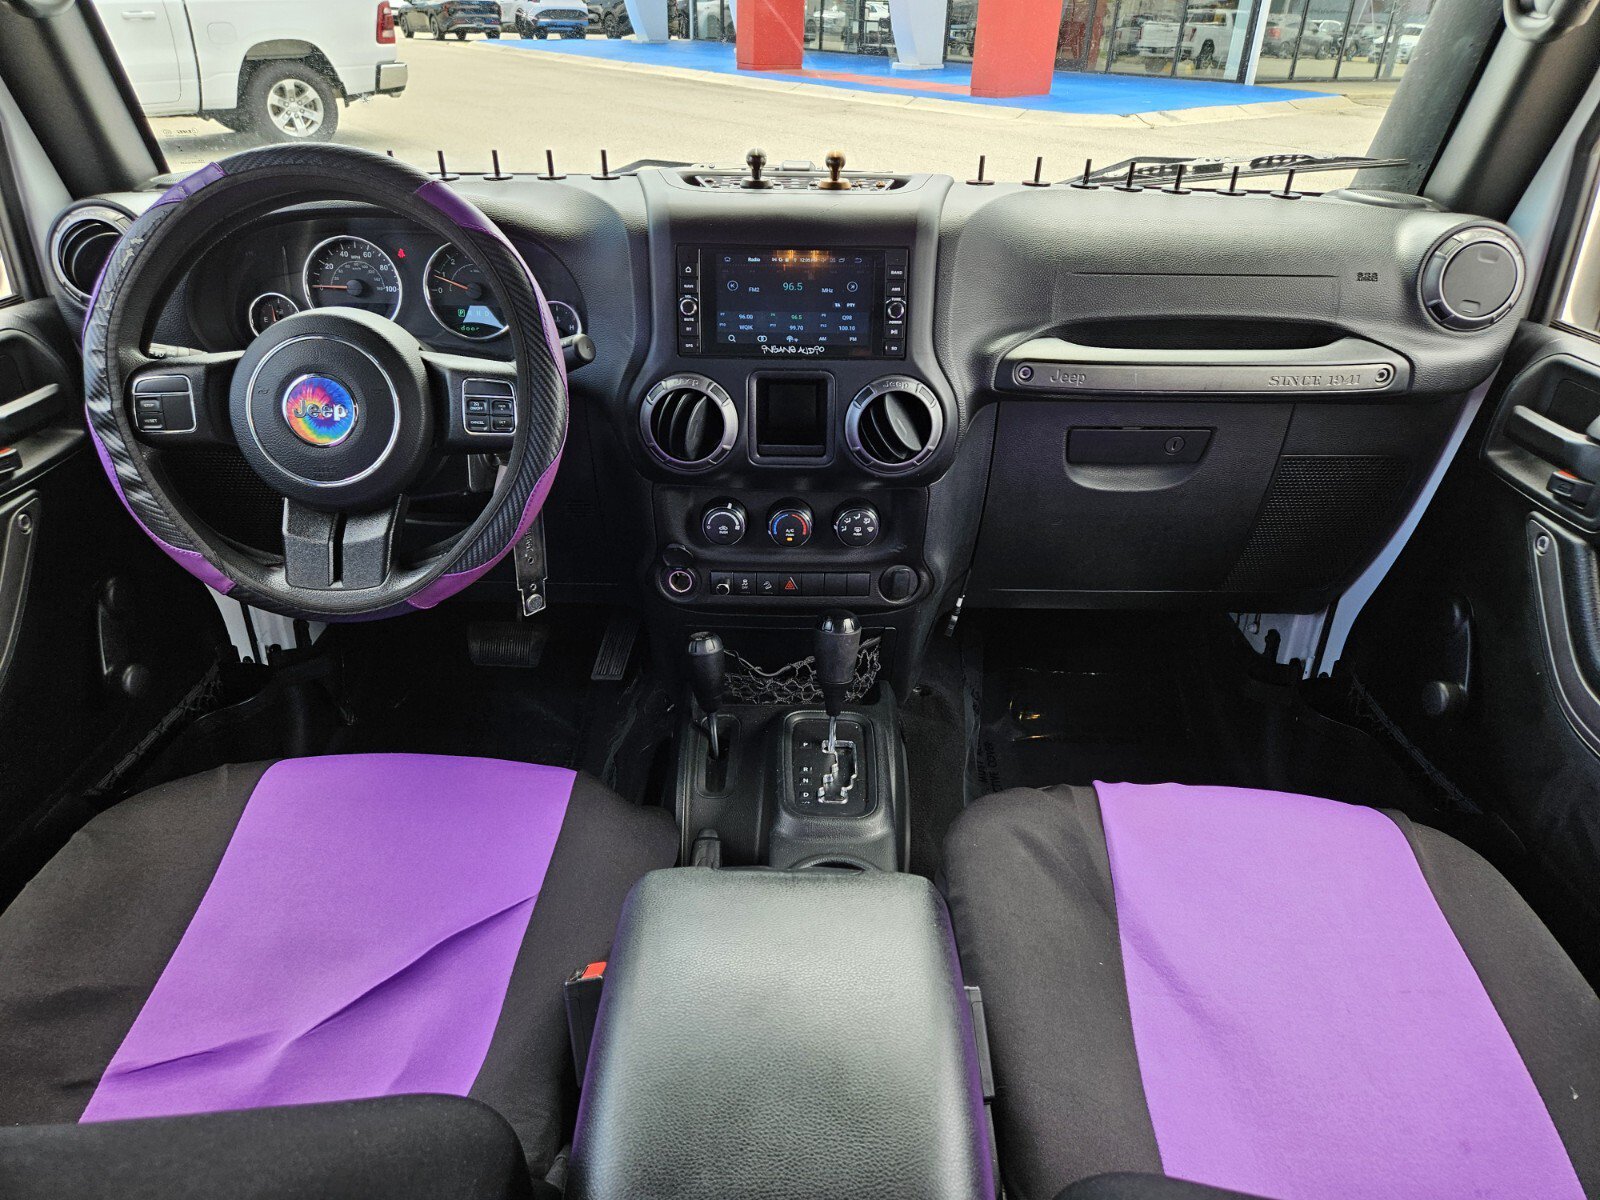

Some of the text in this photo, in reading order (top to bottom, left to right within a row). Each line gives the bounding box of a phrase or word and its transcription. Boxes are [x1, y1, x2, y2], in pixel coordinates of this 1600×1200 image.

[782, 282, 803, 291] 96.5
[1050, 368, 1087, 387] Jeep
[1267, 374, 1361, 387] SINCE 1941
[882, 381, 909, 390] Jeep
[293, 399, 349, 421] Jeep
